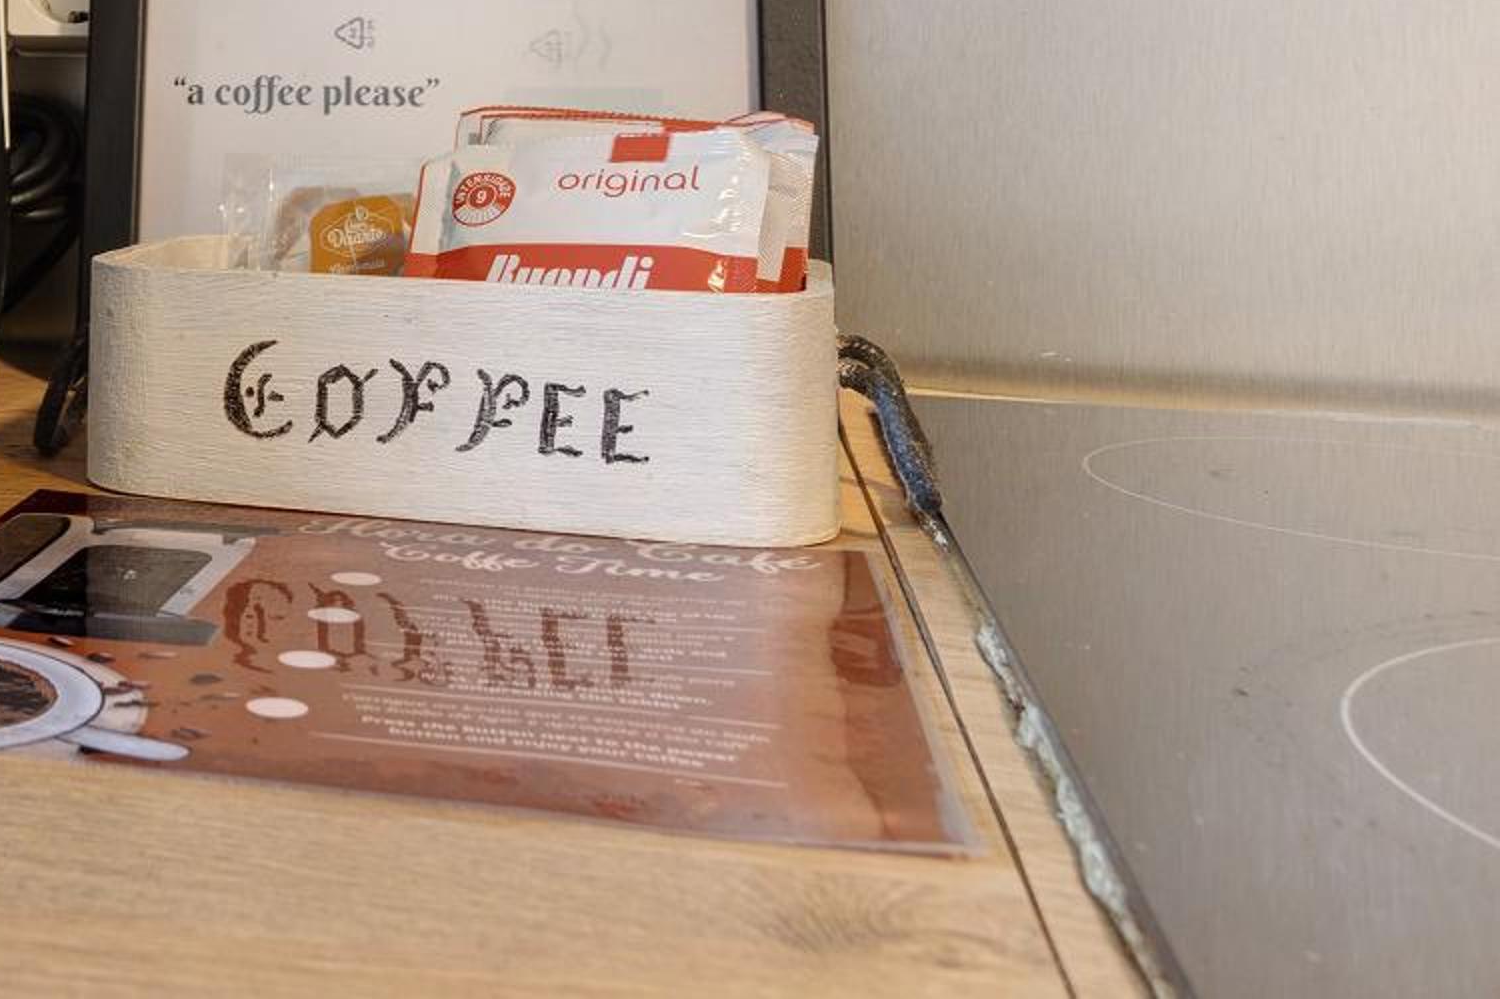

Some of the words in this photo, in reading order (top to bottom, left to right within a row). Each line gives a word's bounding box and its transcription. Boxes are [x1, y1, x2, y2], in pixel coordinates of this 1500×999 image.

[215, 75, 312, 114] coffee
[558, 165, 700, 198] original
[224, 340, 650, 464] COFFEE
[380, 542, 540, 572] Coffe
[555, 555, 725, 583] Time
